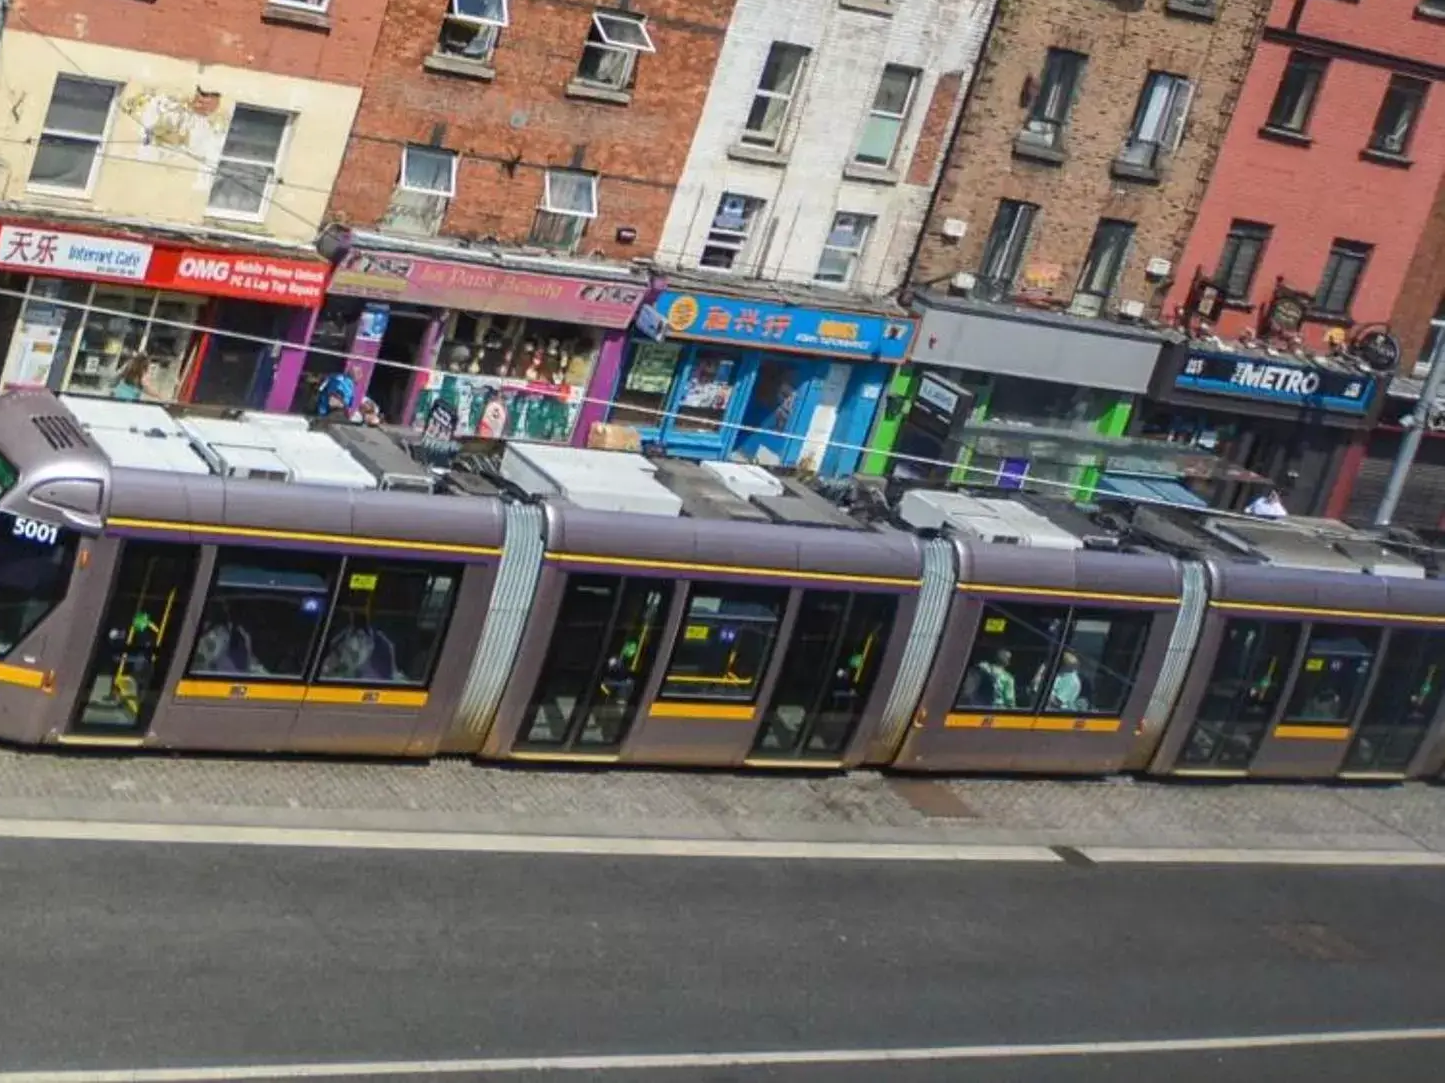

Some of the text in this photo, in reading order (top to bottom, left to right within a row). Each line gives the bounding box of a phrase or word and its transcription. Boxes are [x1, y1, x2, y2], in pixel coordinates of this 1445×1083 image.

[4, 231, 60, 263] 天乐
[68, 244, 113, 265] Internet
[179, 257, 229, 282] OMG
[1238, 364, 1319, 394] METRO
[13, 517, 57, 545] 5001
